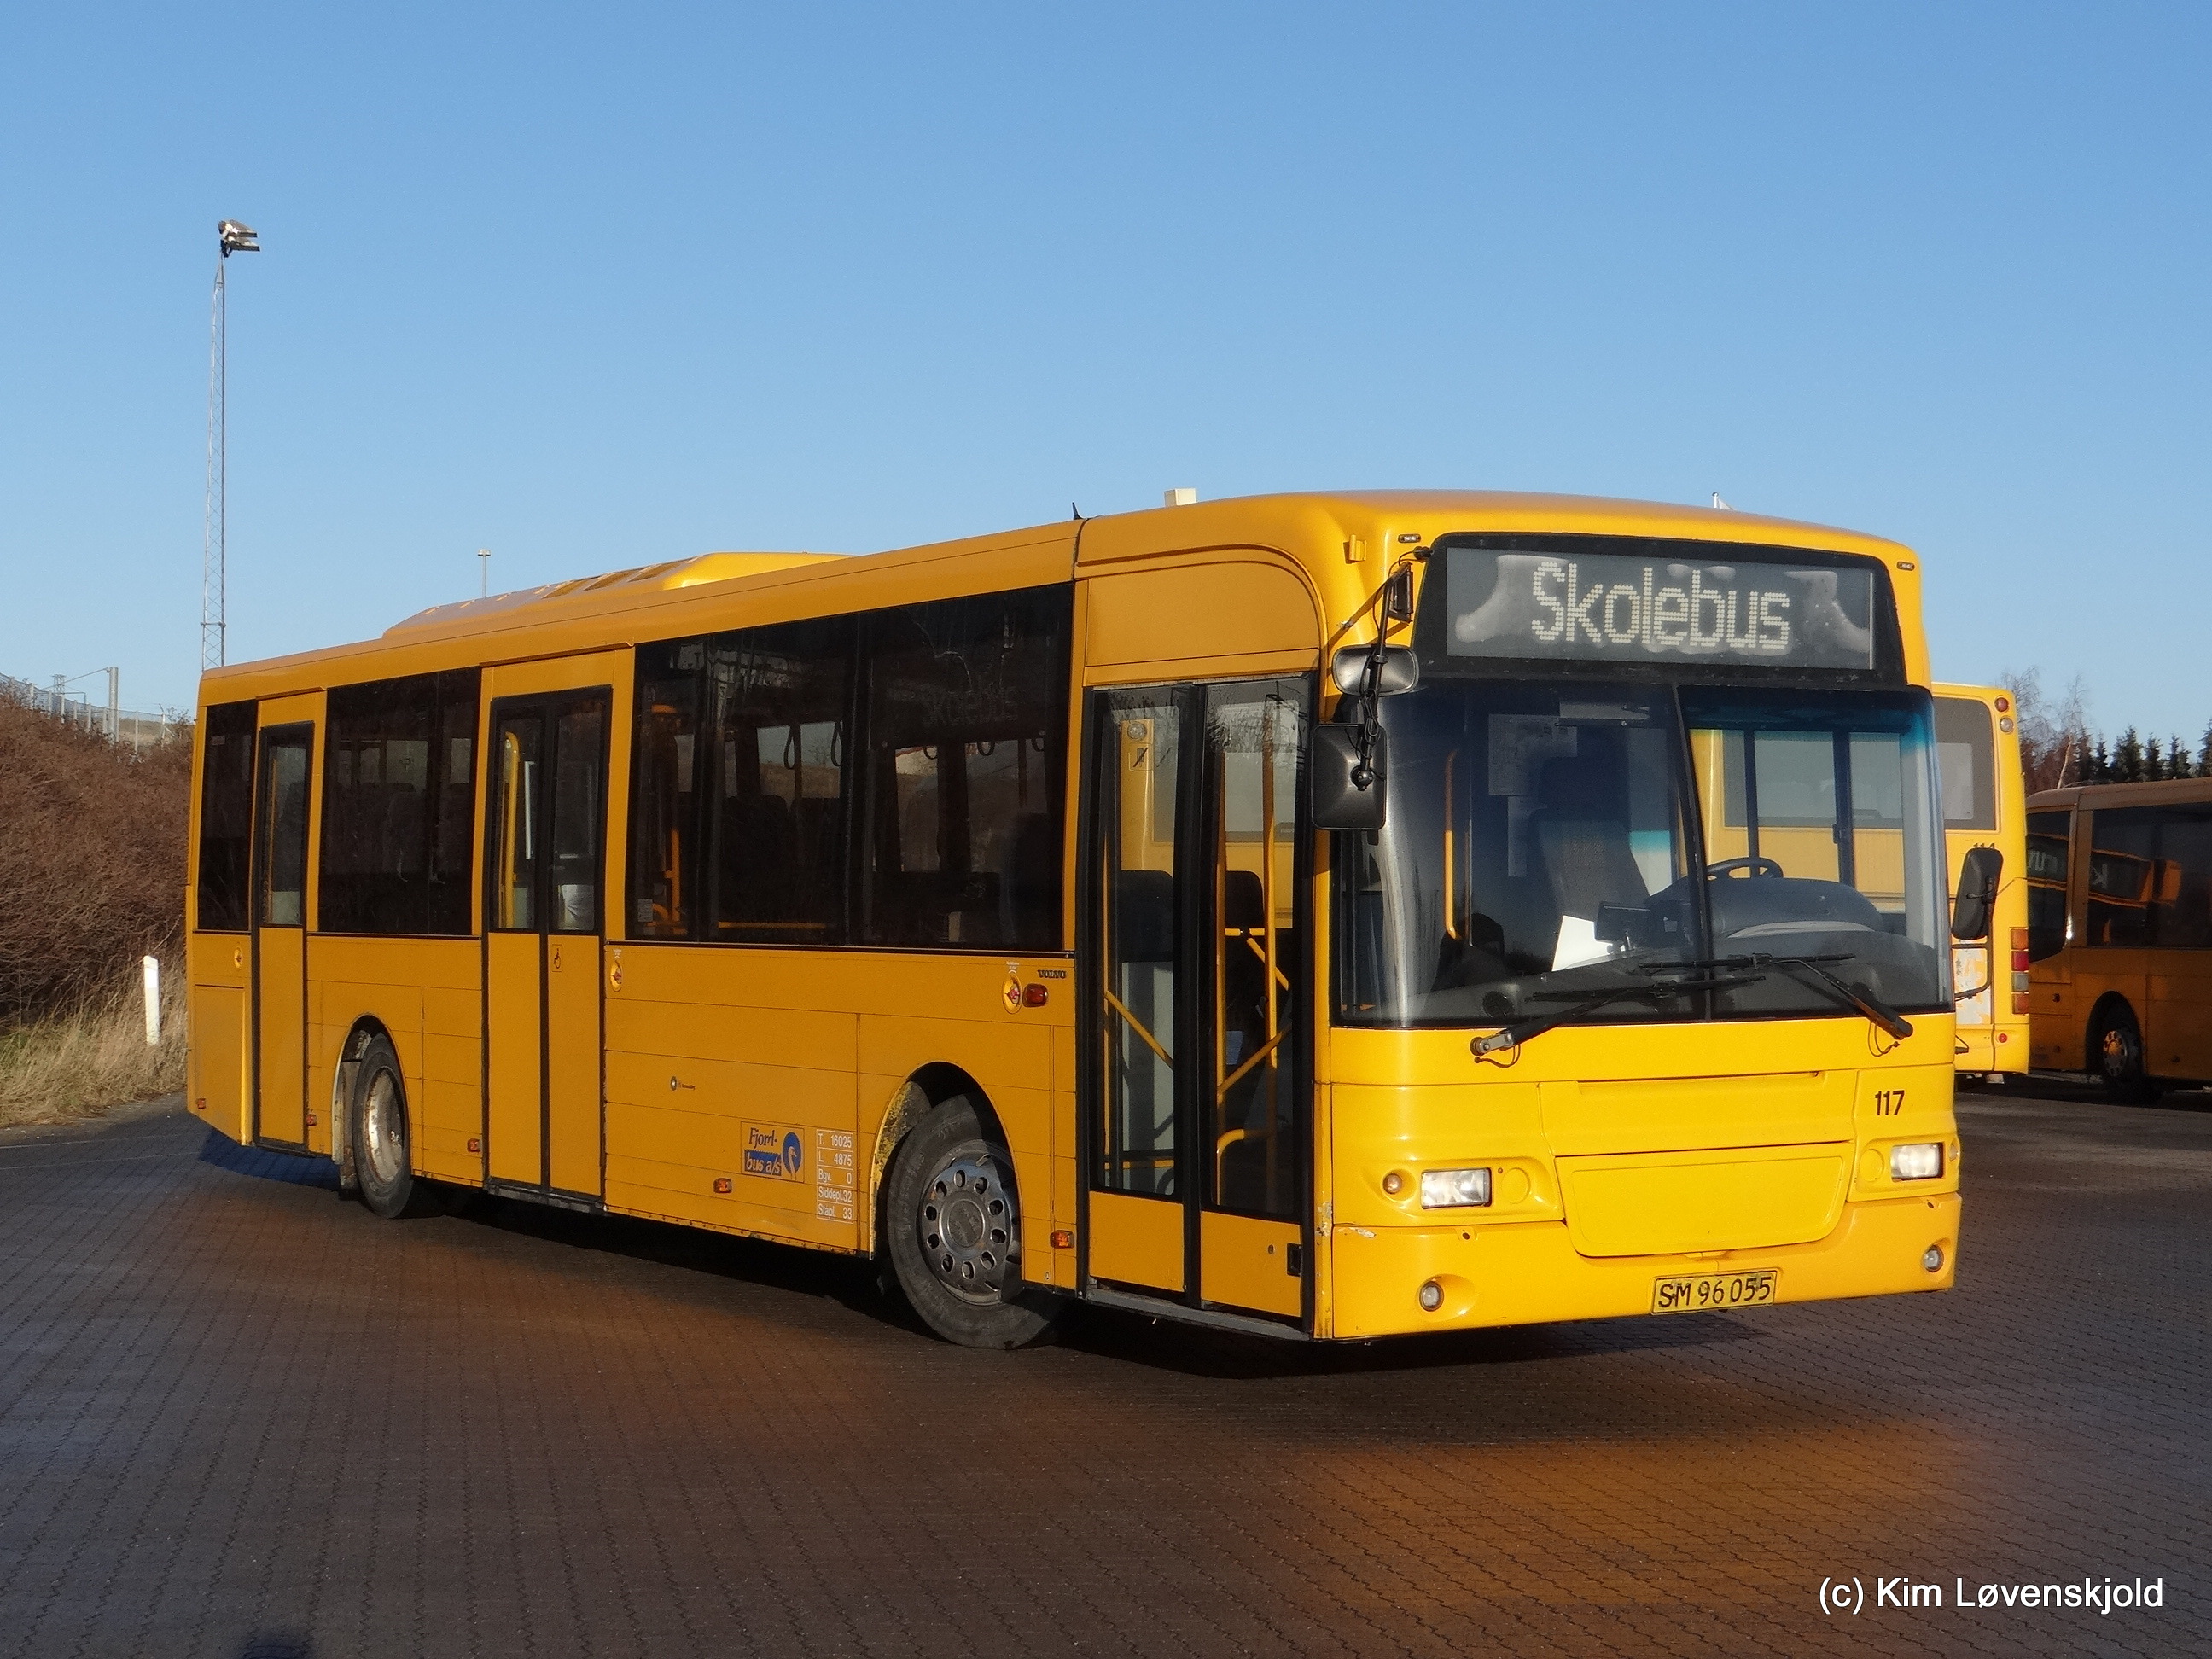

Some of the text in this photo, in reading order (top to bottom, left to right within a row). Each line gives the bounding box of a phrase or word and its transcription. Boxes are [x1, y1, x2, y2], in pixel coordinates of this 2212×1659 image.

[1532, 562, 1790, 649] Skolebus
[1037, 969, 1067, 979] VOLVO
[1874, 1090, 1905, 1115] 117
[830, 1134, 852, 1149] 16025
[747, 1151, 781, 1176] bus a/s
[834, 1153, 852, 1167] 4875
[818, 1168, 832, 1183] Bgv.
[843, 1207, 853, 1220] 33
[1657, 1276, 1772, 1308] SM 96 055
